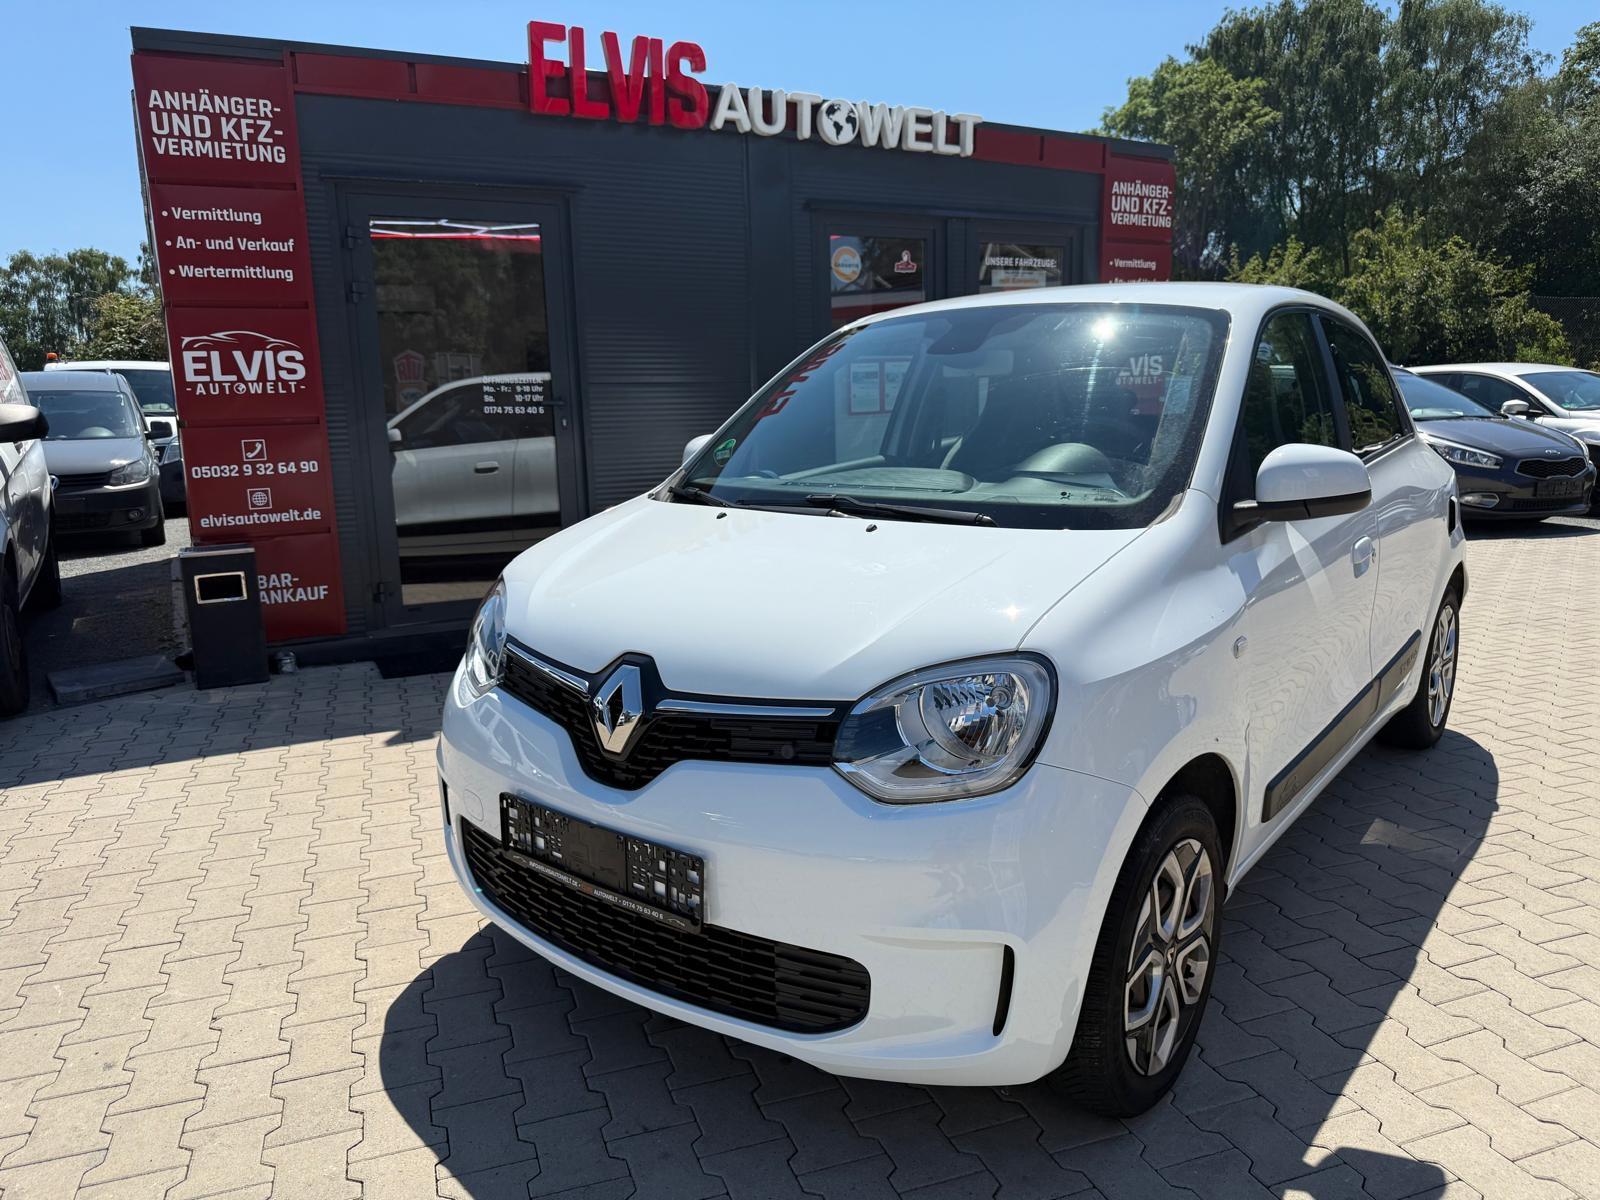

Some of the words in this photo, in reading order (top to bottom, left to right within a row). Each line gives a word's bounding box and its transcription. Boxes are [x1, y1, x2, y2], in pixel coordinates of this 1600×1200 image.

[526, 20, 708, 130] ELVIS
[709, 82, 984, 158] AUTOWELT
[149, 88, 281, 118] ANHÄNGER-
[151, 111, 212, 138] UND
[220, 116, 284, 143] KFZ-
[152, 137, 287, 164] VERMIETUNG
[1111, 180, 1173, 198] ANHÄNGER-
[1111, 195, 1140, 213] UND
[1143, 198, 1172, 215] KFZ-
[171, 206, 262, 226] Vermittlung
[1110, 212, 1172, 228] VERMIETUNG
[176, 235, 202, 250] An-
[205, 236, 234, 250] und
[237, 237, 295, 252] Verkauf
[984, 256, 1014, 267] UNSERE
[1114, 258, 1157, 271] Vermittlung
[178, 265, 293, 282] Wertermittlung
[182, 350, 306, 382] ELVIS
[531, 394, 544, 402] Uhr
[484, 406, 502, 414] 0174
[503, 406, 513, 414] 75
[526, 406, 537, 414] 40
[191, 464, 239, 479] 05032
[243, 463, 252, 476] 9
[256, 462, 275, 476] 32
[278, 461, 297, 474] 64
[300, 460, 319, 473] 90
[200, 508, 322, 528] elvisautowelt.de
[257, 572, 299, 590] BAR-
[259, 585, 328, 605] ANKAUF
